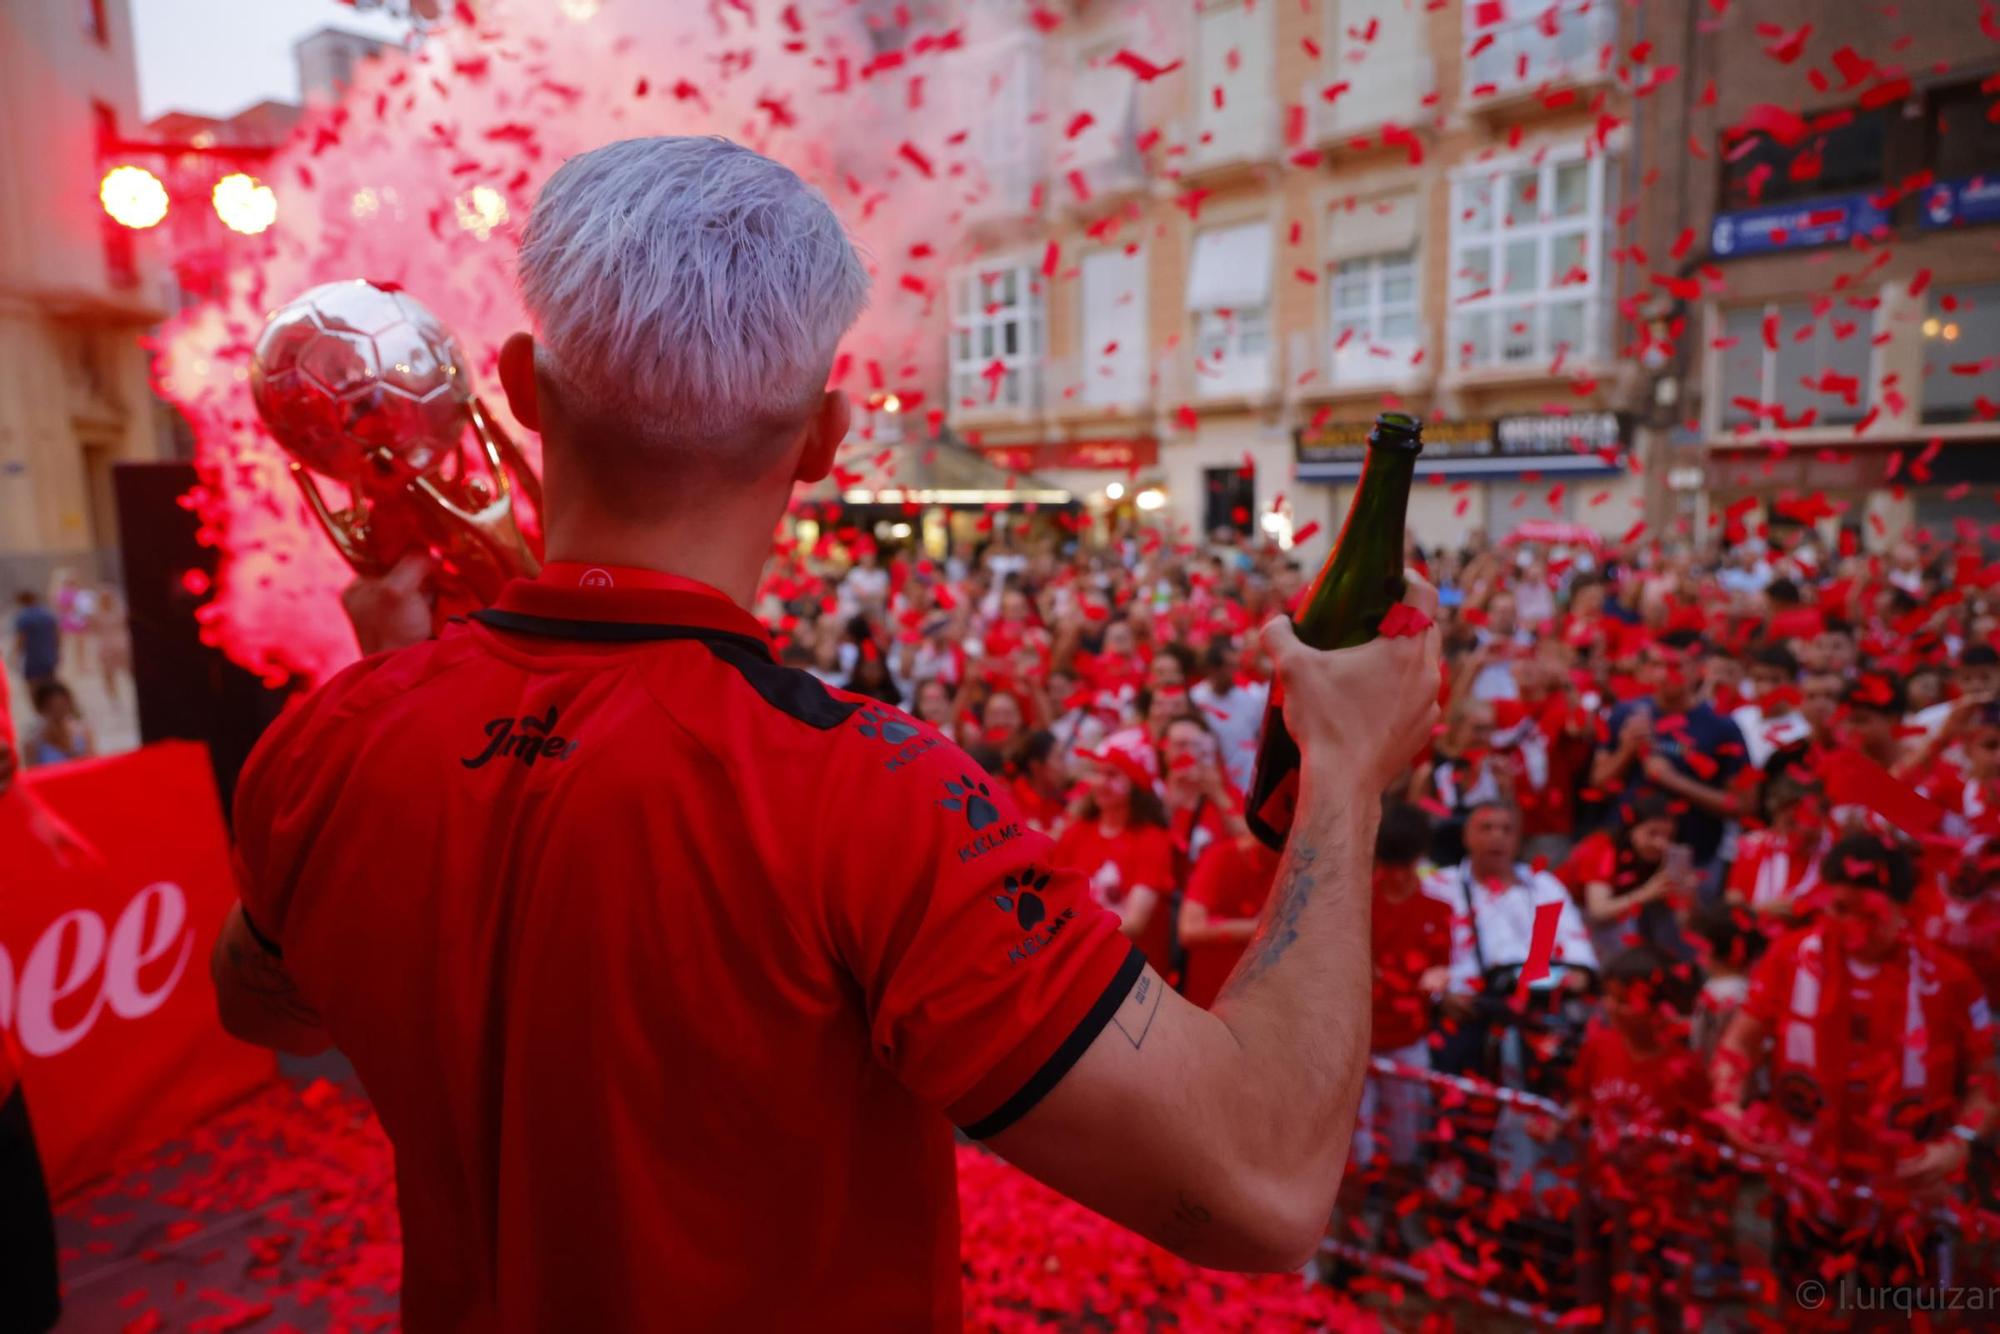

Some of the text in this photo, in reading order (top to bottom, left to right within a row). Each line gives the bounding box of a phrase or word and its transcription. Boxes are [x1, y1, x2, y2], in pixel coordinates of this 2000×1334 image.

[959, 823, 1023, 863] KELME
[1008, 907, 1079, 965] KELME
[0, 881, 196, 1058] ee
